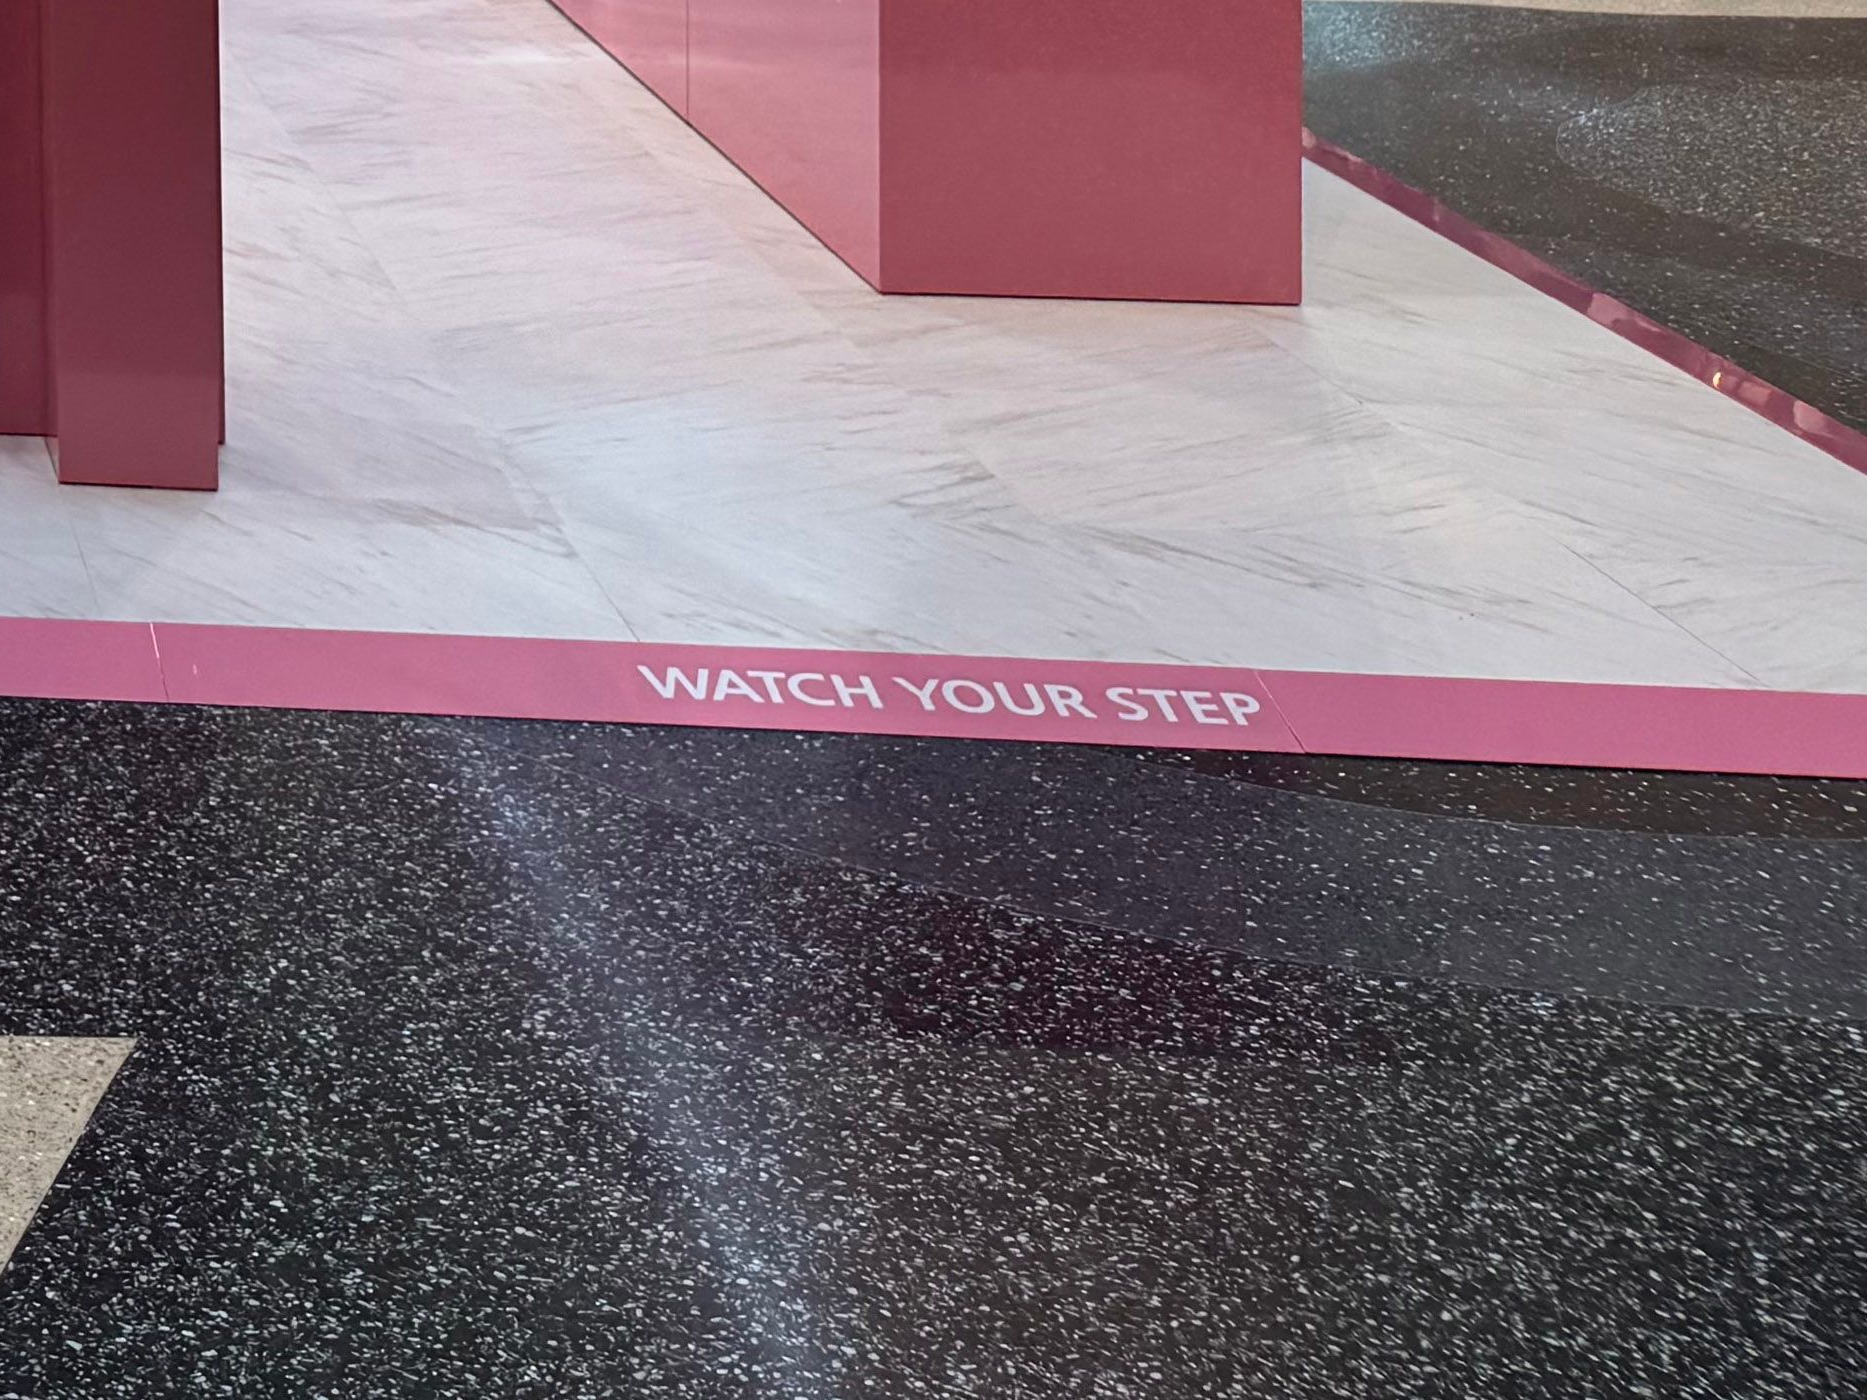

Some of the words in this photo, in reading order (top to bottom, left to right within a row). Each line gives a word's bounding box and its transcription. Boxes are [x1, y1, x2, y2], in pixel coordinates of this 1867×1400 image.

[637, 664, 884, 709] WATCH
[893, 676, 1098, 720] YOUR
[1105, 687, 1262, 727] STEP
